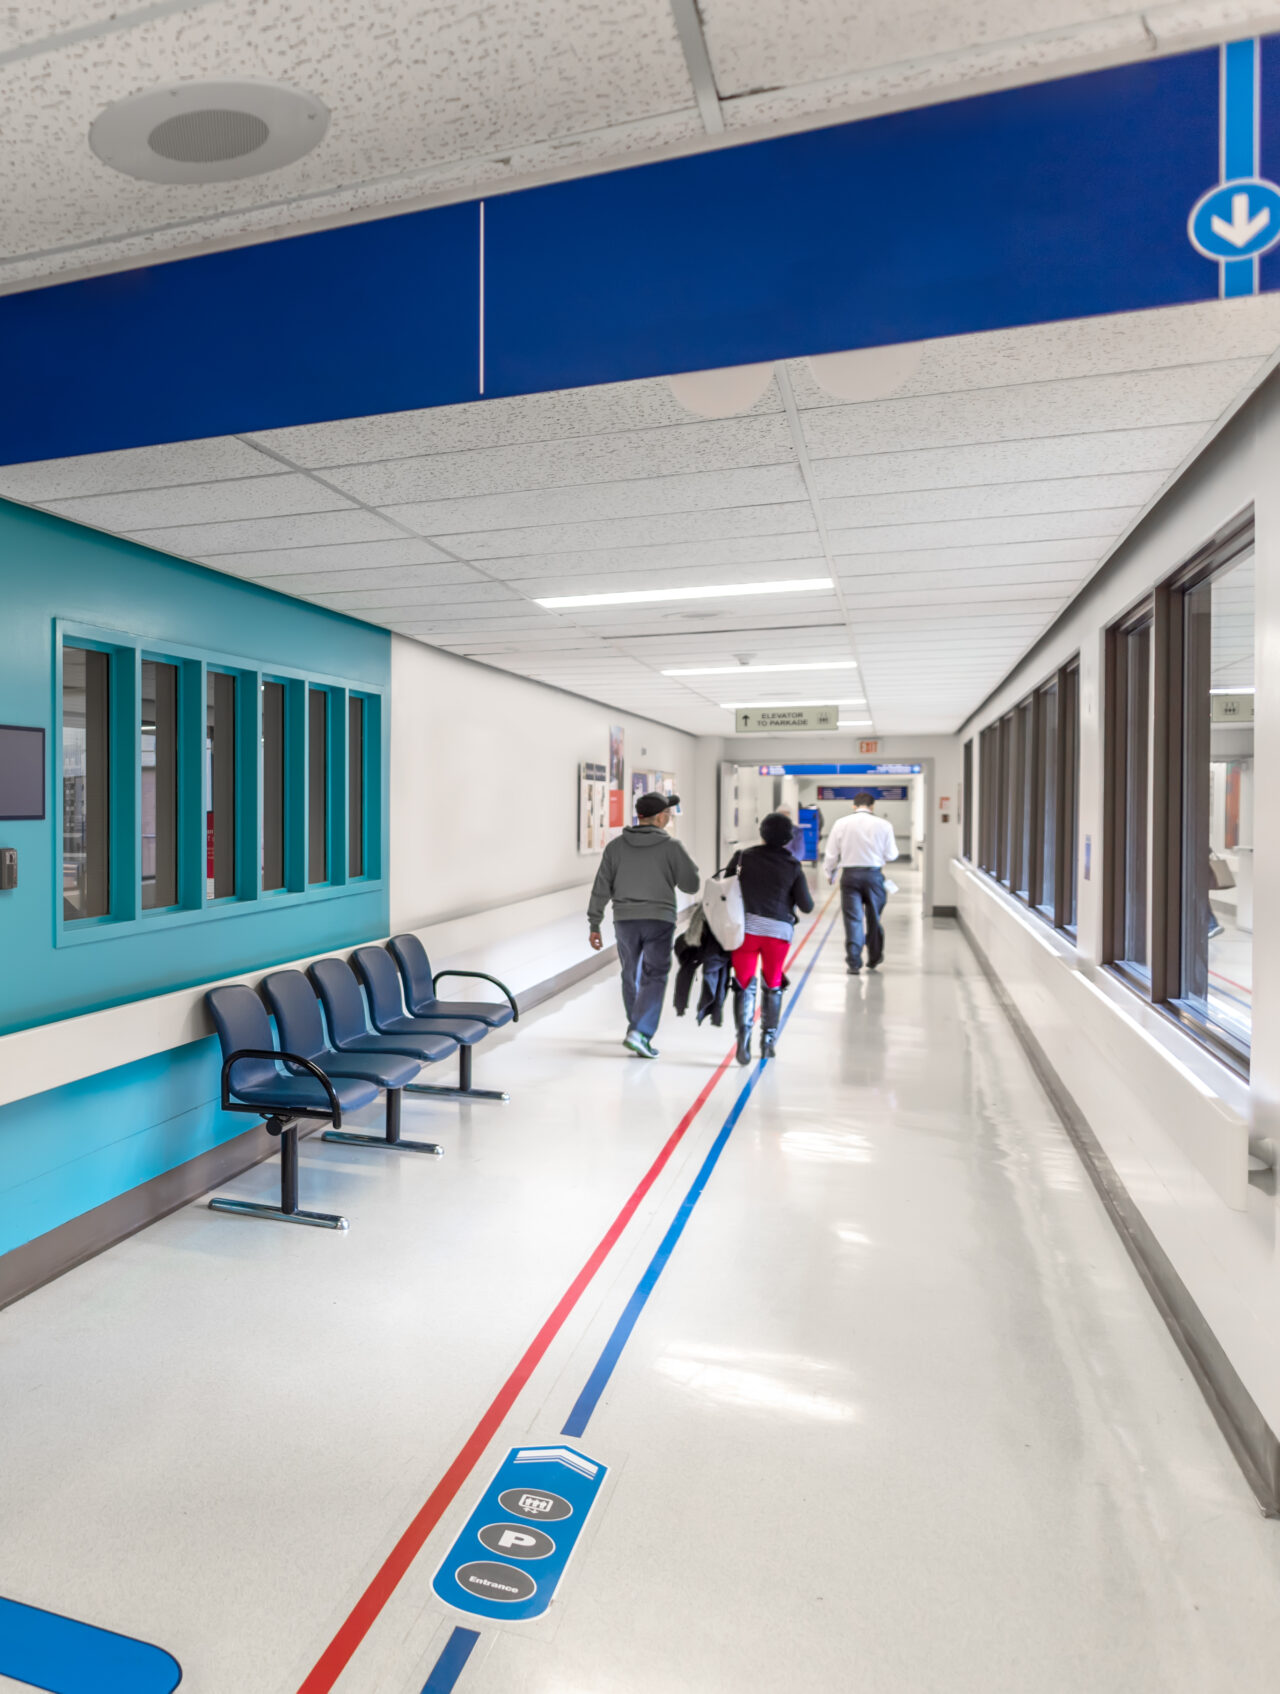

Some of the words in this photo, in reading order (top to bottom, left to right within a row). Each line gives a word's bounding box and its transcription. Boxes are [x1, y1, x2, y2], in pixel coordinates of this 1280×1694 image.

[860, 741, 878, 753] EXIT
[498, 1530, 537, 1547] P
[469, 1576, 519, 1594] Entrance
